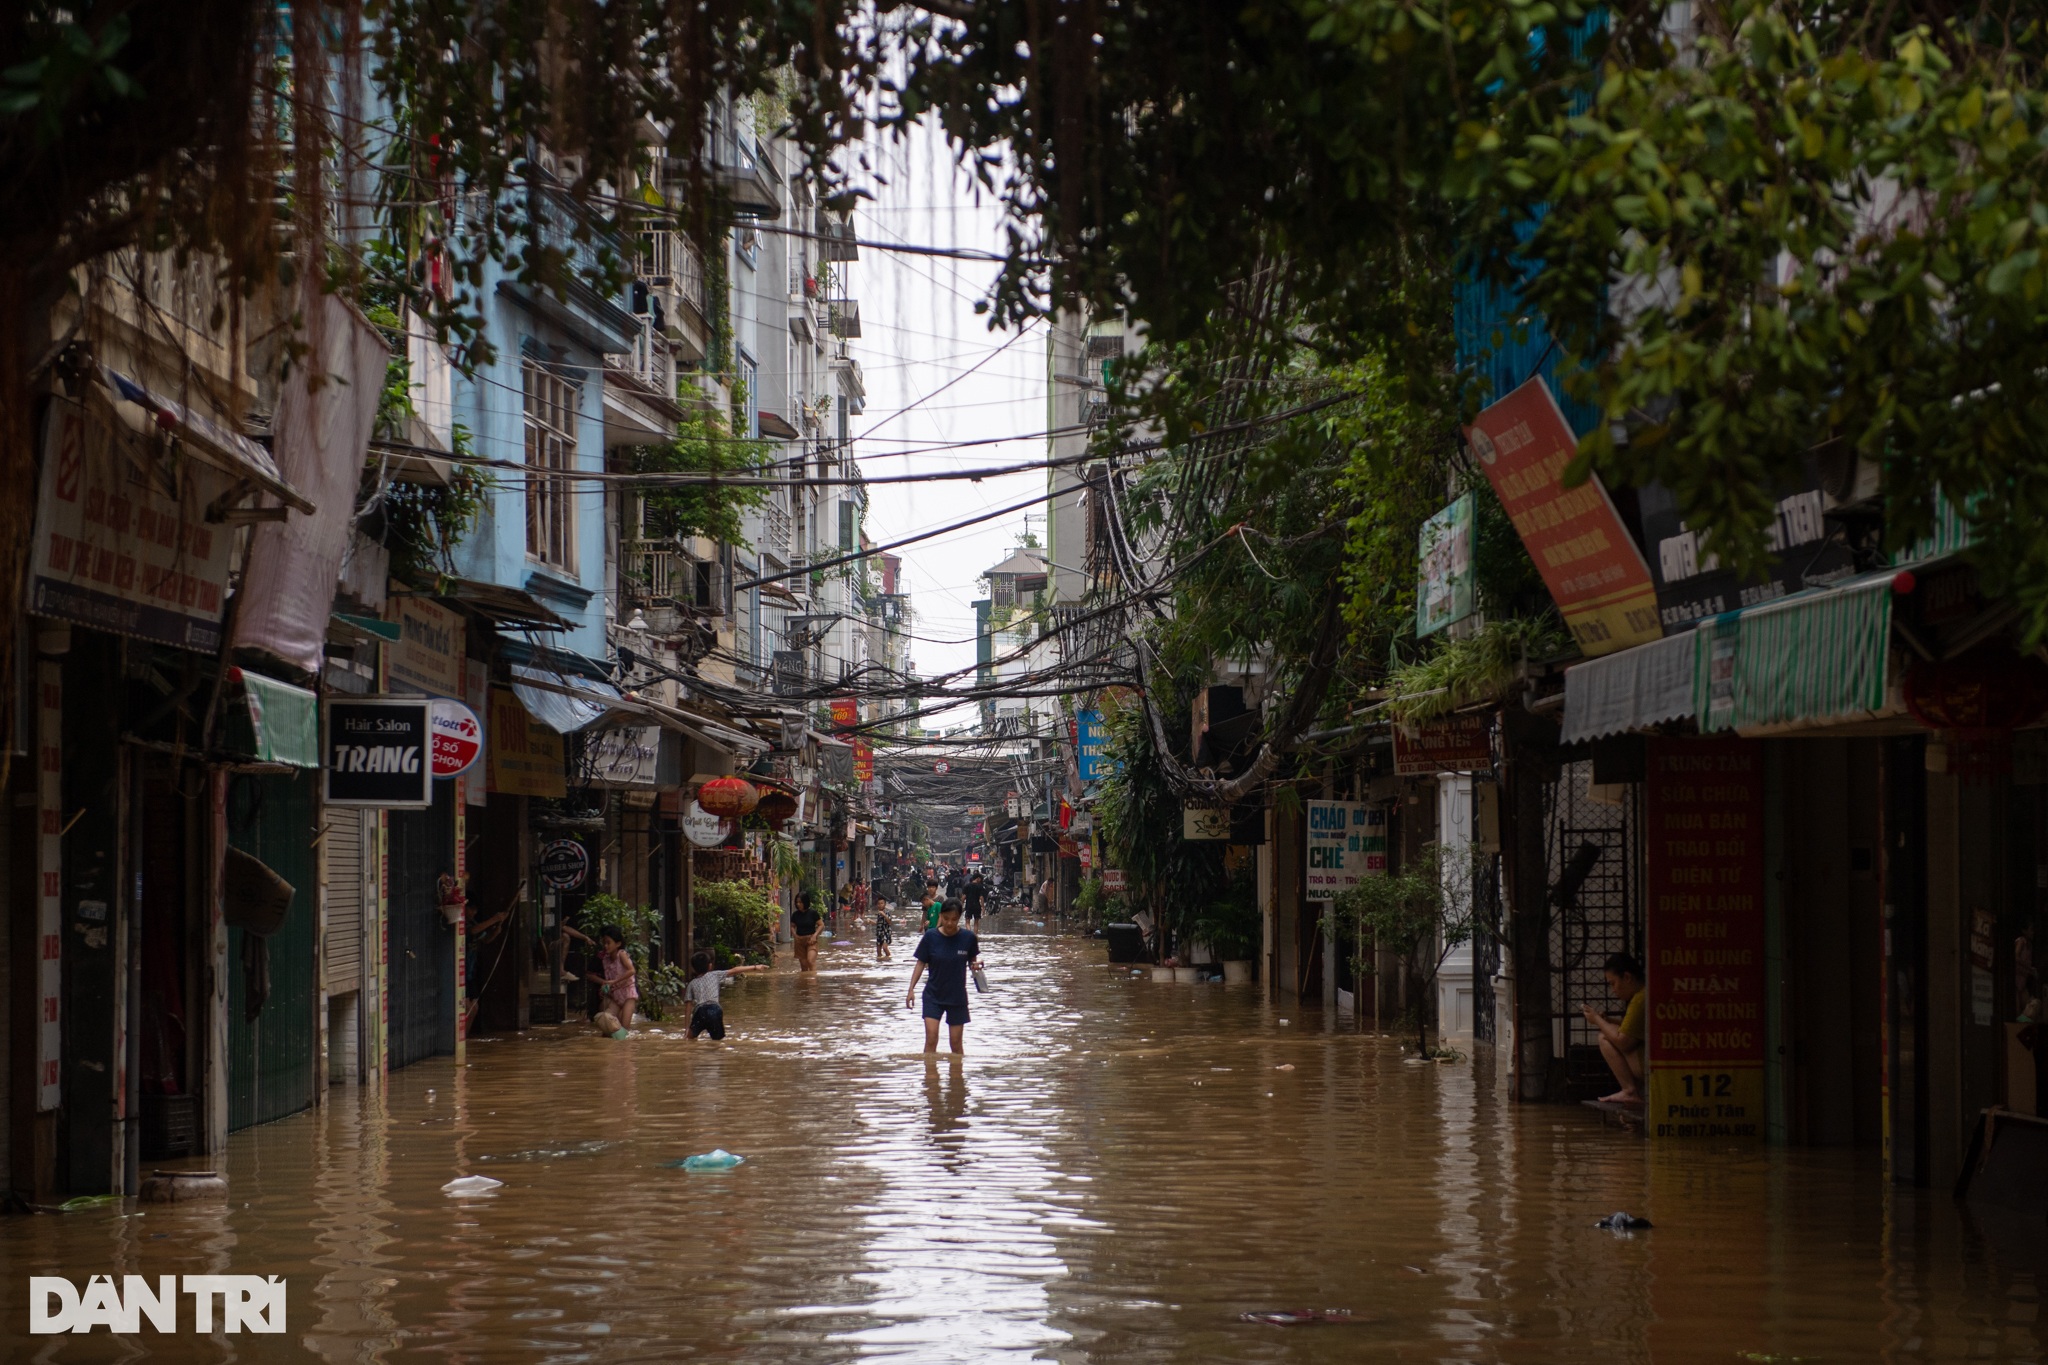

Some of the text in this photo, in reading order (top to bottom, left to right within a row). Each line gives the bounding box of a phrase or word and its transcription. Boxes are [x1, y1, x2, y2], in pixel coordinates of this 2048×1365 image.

[345, 718, 411, 732] Hair Salon
[442, 741, 460, 754] SỐ
[335, 744, 420, 774] TRANG
[432, 753, 463, 768] CHỌN
[1660, 751, 1752, 771] TRUNG TÂM
[1661, 782, 1750, 802] SỬA CHỮA
[1310, 803, 1346, 829] CHÁO
[1663, 809, 1748, 830] MUA BÁN
[1362, 836, 1386, 851] XANH
[1665, 834, 1747, 858] TRAO ĐỔI
[1310, 842, 1345, 869] CHÈ
[1367, 855, 1386, 870] SEN
[541, 861, 585, 873] BARBER SHOP
[1671, 864, 1714, 887] ĐIỆN
[1659, 892, 1754, 915] ĐIỆN LẠNH
[1684, 919, 1728, 942] ĐIỆN
[1660, 945, 1753, 968] DÂN DỤNG
[1672, 973, 1740, 993] NHẬN
[1655, 998, 1758, 1020] CÔNG TRÌNH
[1661, 1027, 1752, 1053] ĐIỆN NƯỚC
[1681, 1073, 1732, 1097] 112
[1668, 1104, 1745, 1118] Phúc Tân
